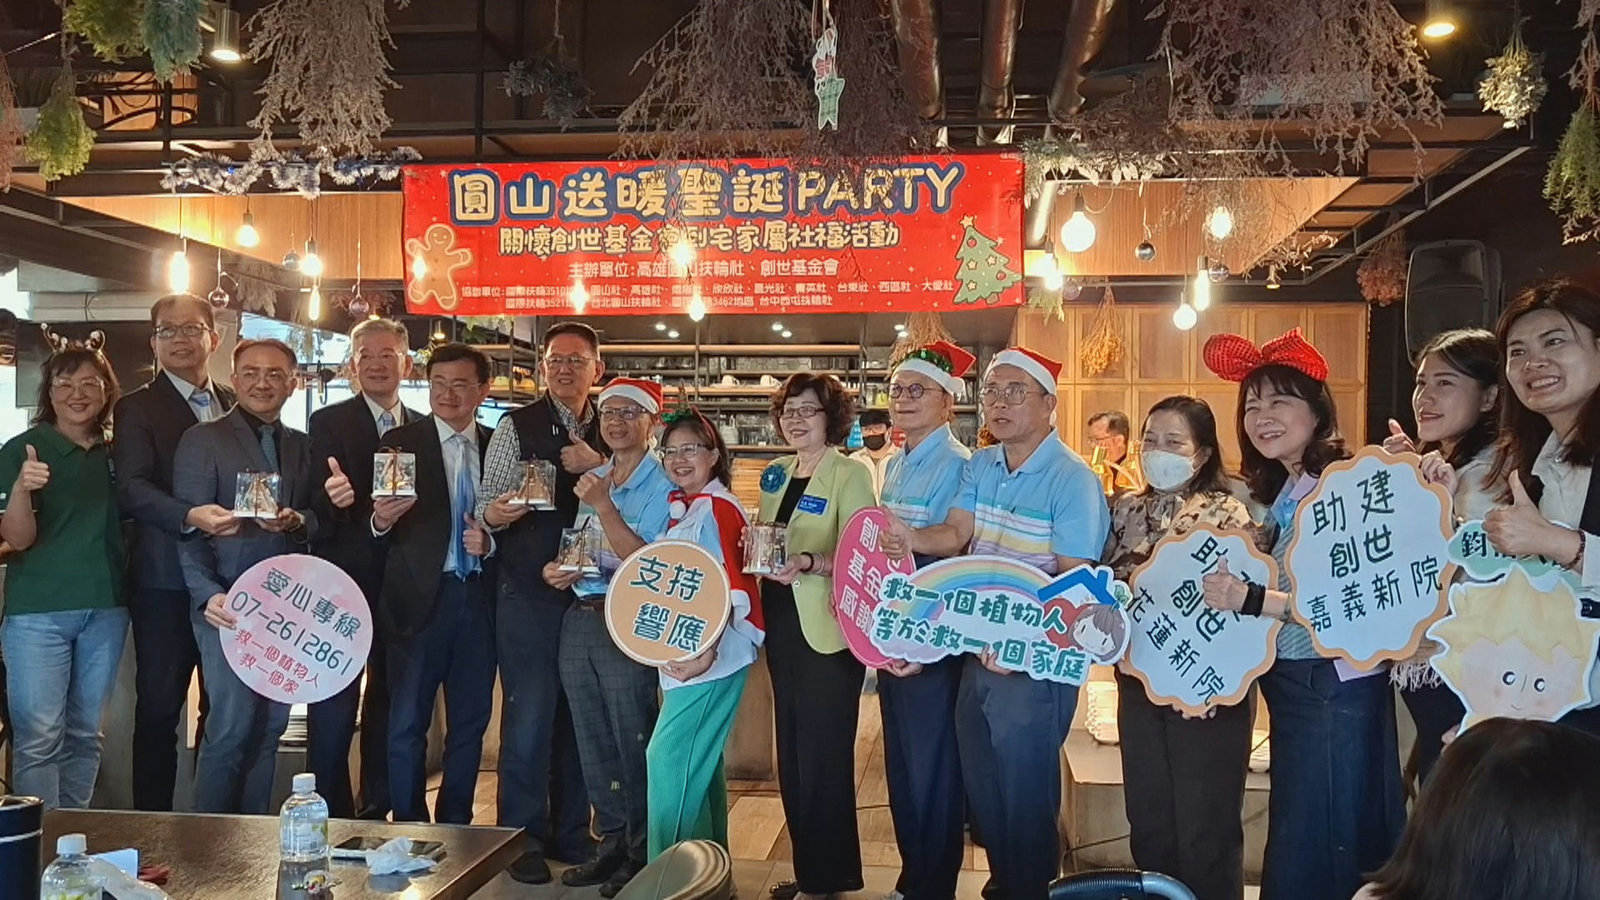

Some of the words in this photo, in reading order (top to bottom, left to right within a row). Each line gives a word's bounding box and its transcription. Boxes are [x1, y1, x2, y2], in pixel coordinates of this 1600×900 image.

[506, 298, 581, 309] 國際扶輪3521
[1313, 469, 1394, 535] 助建
[629, 556, 704, 601] 支持
[1329, 524, 1394, 578] 創世
[261, 567, 362, 641] 愛心專線
[882, 577, 1068, 634] 救一個植物人
[1170, 579, 1227, 642] 創世
[1307, 555, 1443, 632] 嘉義新院
[231, 591, 353, 675] 07-2612861
[235, 628, 320, 688] 救一個植物人
[633, 603, 707, 653] 響應
[874, 607, 1088, 681] 等於救一個家庭
[1126, 587, 1226, 705] 花蓮新院
[240, 652, 300, 695] 救一個家
